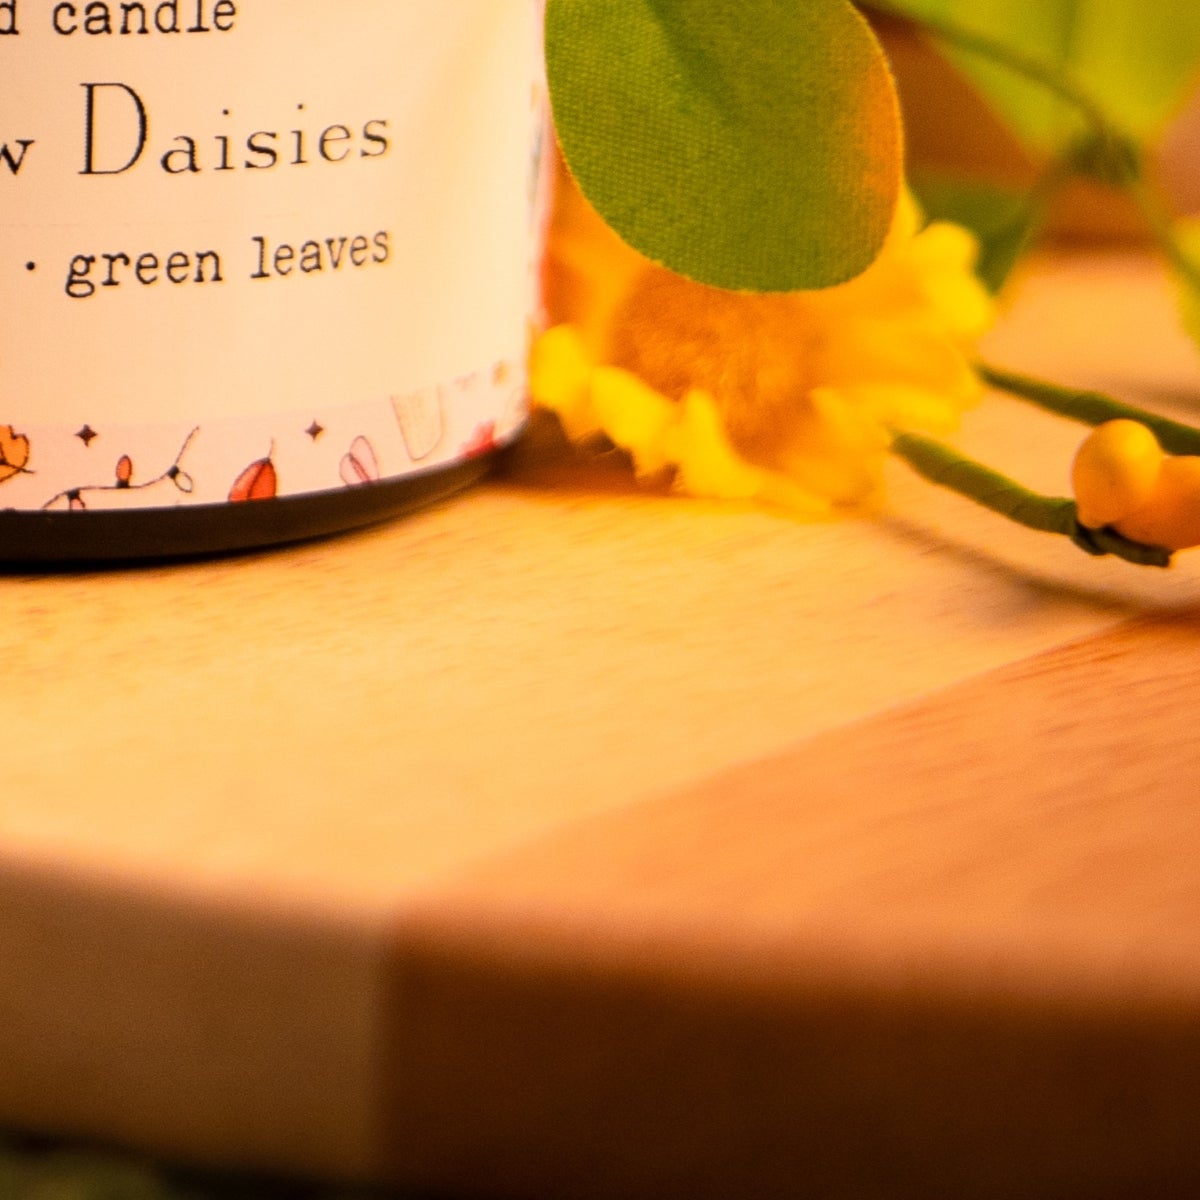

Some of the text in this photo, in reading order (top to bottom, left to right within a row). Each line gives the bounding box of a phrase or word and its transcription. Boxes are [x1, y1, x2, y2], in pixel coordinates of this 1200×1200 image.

[77, 81, 392, 176] Daisies
[64, 250, 224, 299] green
[248, 229, 392, 281] leaves
